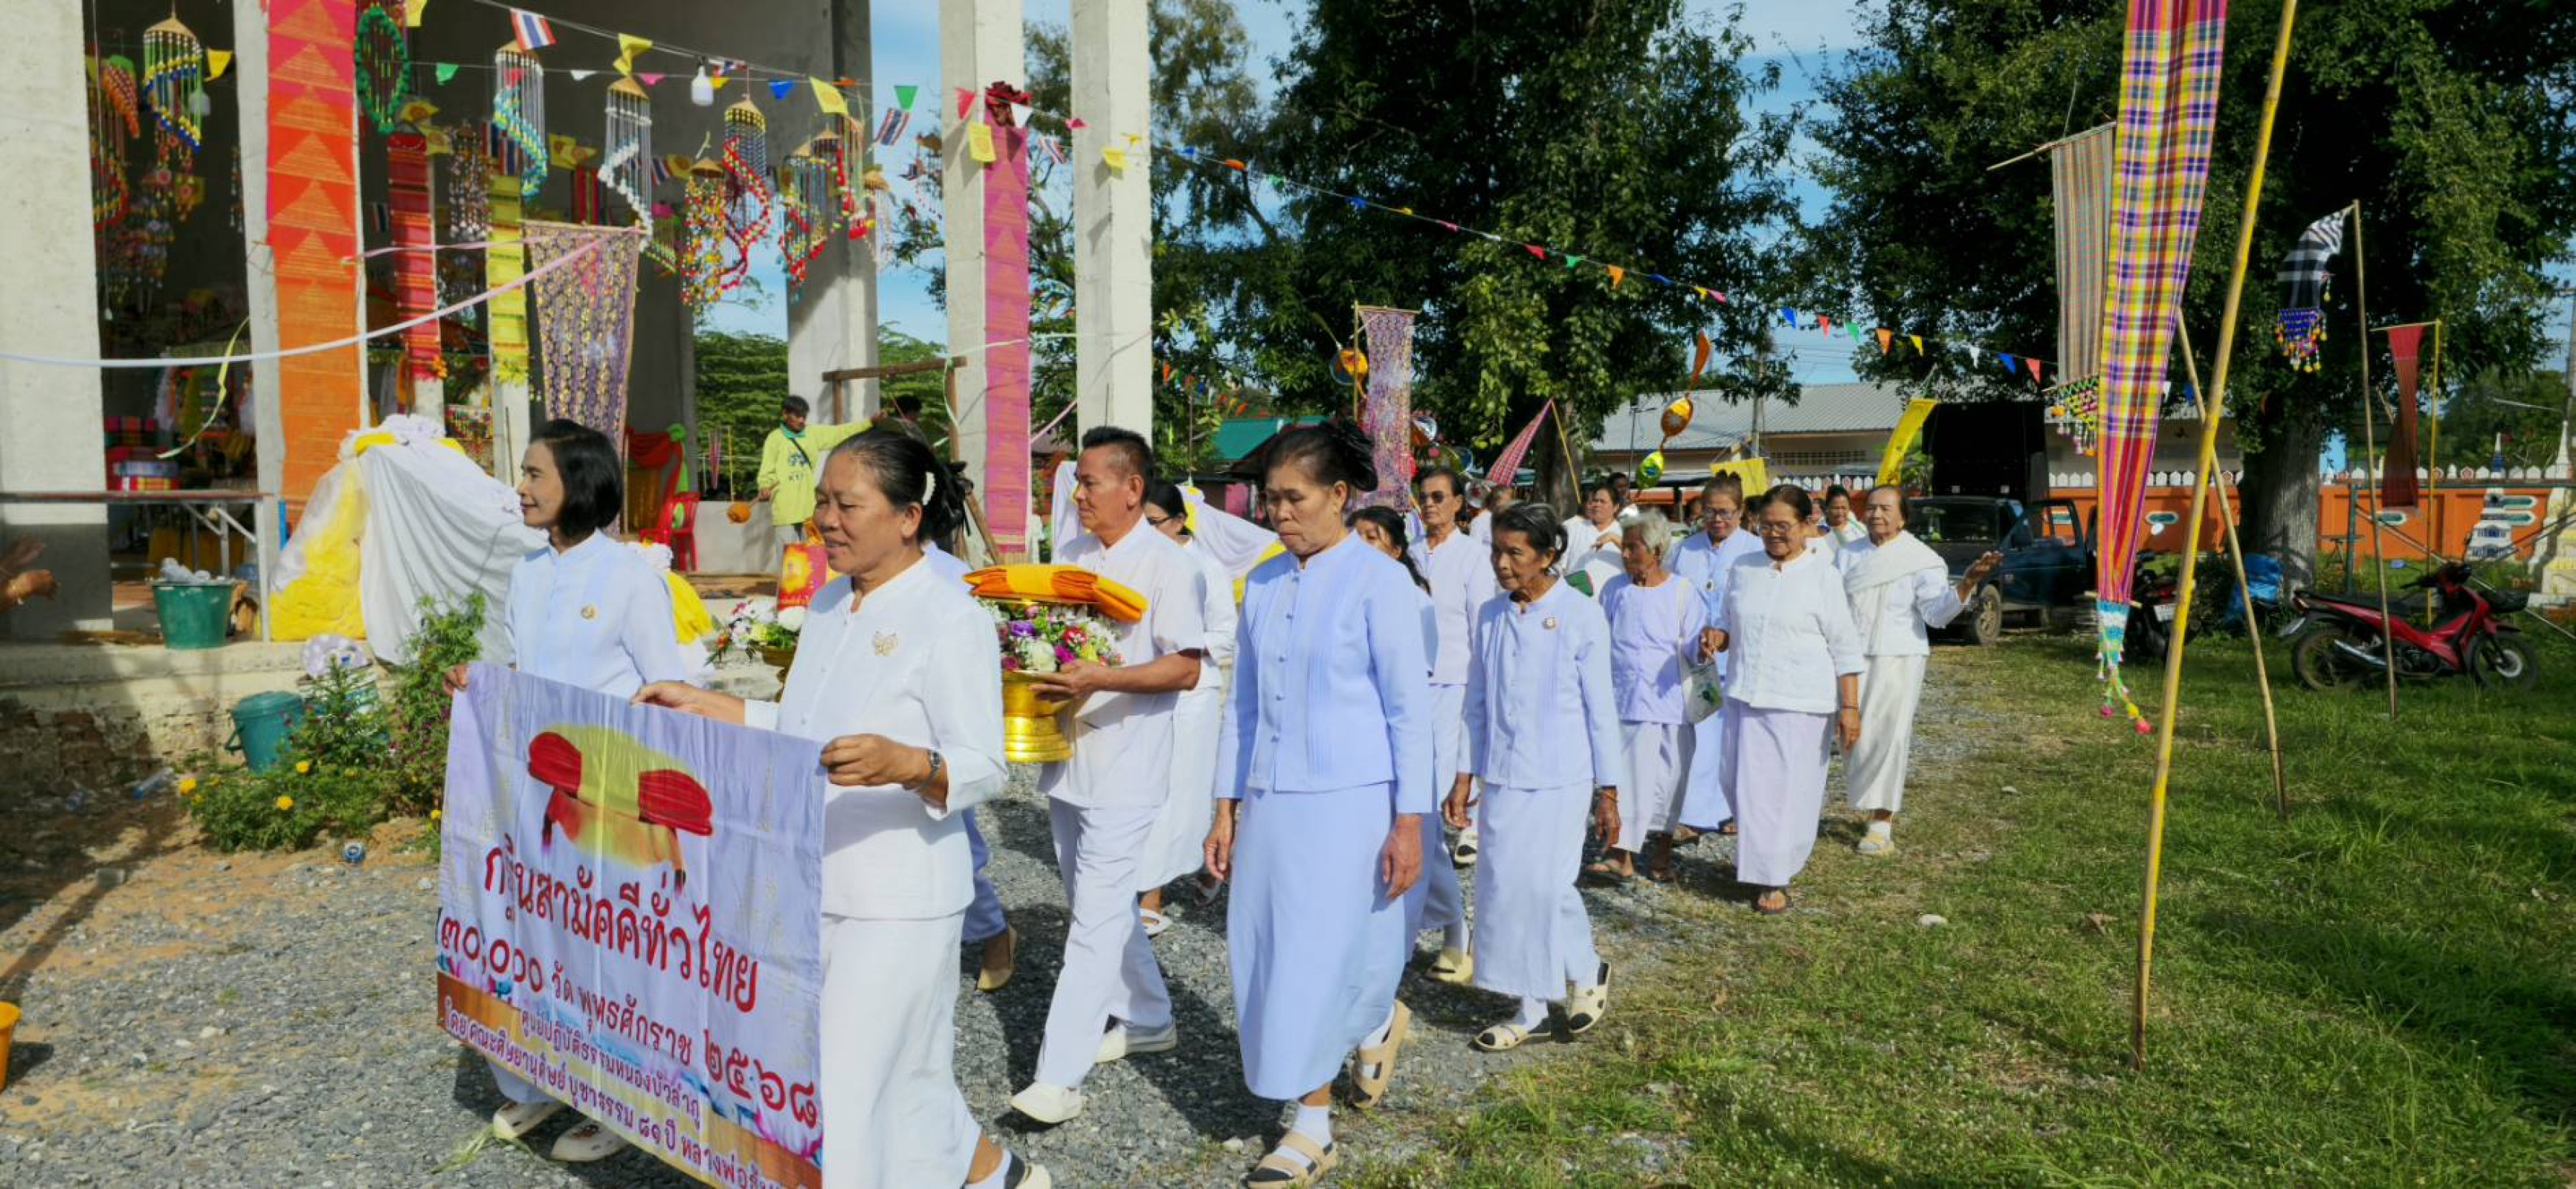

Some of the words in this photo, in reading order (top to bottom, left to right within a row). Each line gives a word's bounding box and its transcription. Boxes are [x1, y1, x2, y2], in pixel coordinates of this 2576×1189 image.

[552, 960, 574, 1004] วัด
[578, 987, 692, 1066] พุทธศักราช
[704, 1028, 817, 1129] ๒๕๖๘
